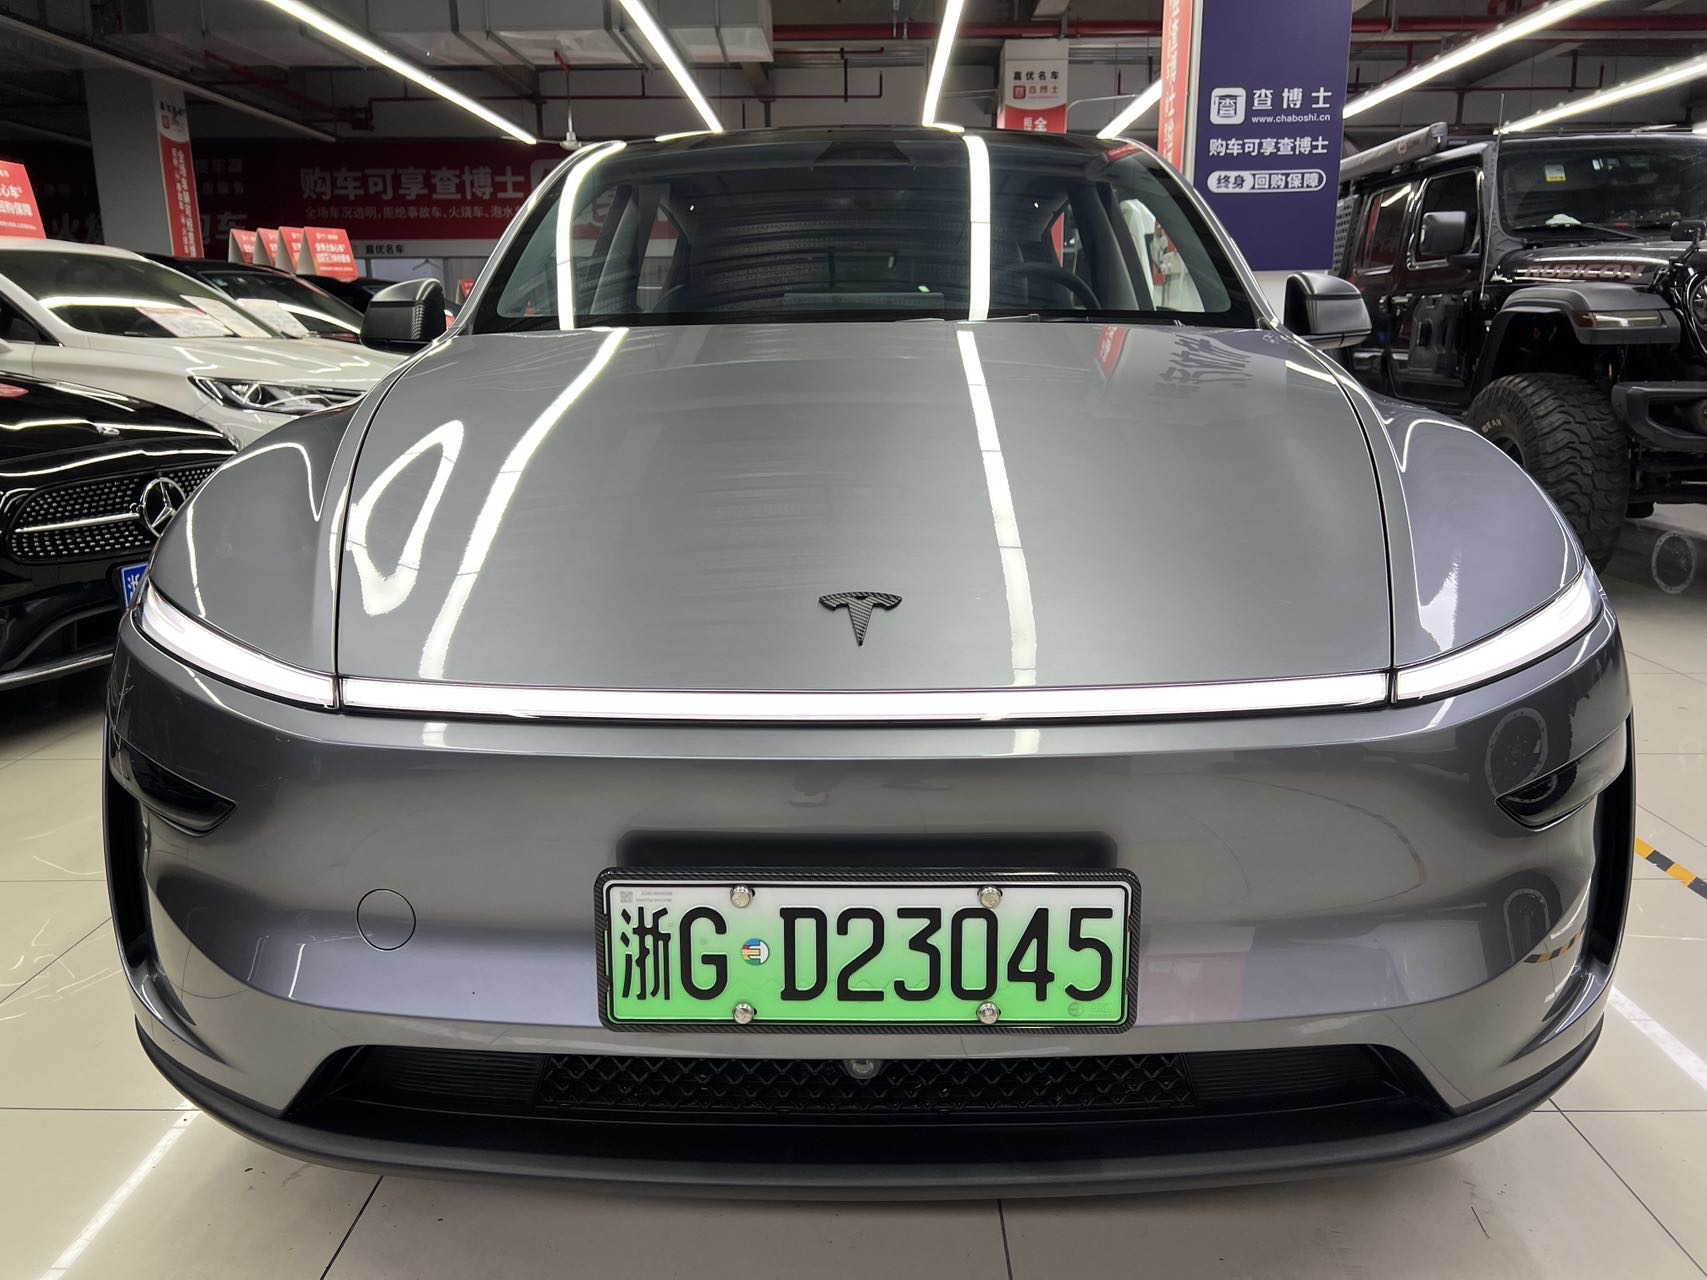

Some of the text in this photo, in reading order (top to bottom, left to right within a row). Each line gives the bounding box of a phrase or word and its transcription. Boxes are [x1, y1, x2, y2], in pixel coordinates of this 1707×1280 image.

[1251, 86, 1333, 110] 查博士
[1251, 113, 1331, 123] www.chaboshi.cn
[1209, 136, 1329, 156] 购车可享查博士
[299, 165, 526, 201] 购车可享查博士
[1216, 172, 1320, 189] 终身 回购保障
[1523, 263, 1647, 279] RUBICON
[619, 906, 1115, 1002] 浙G D23045
